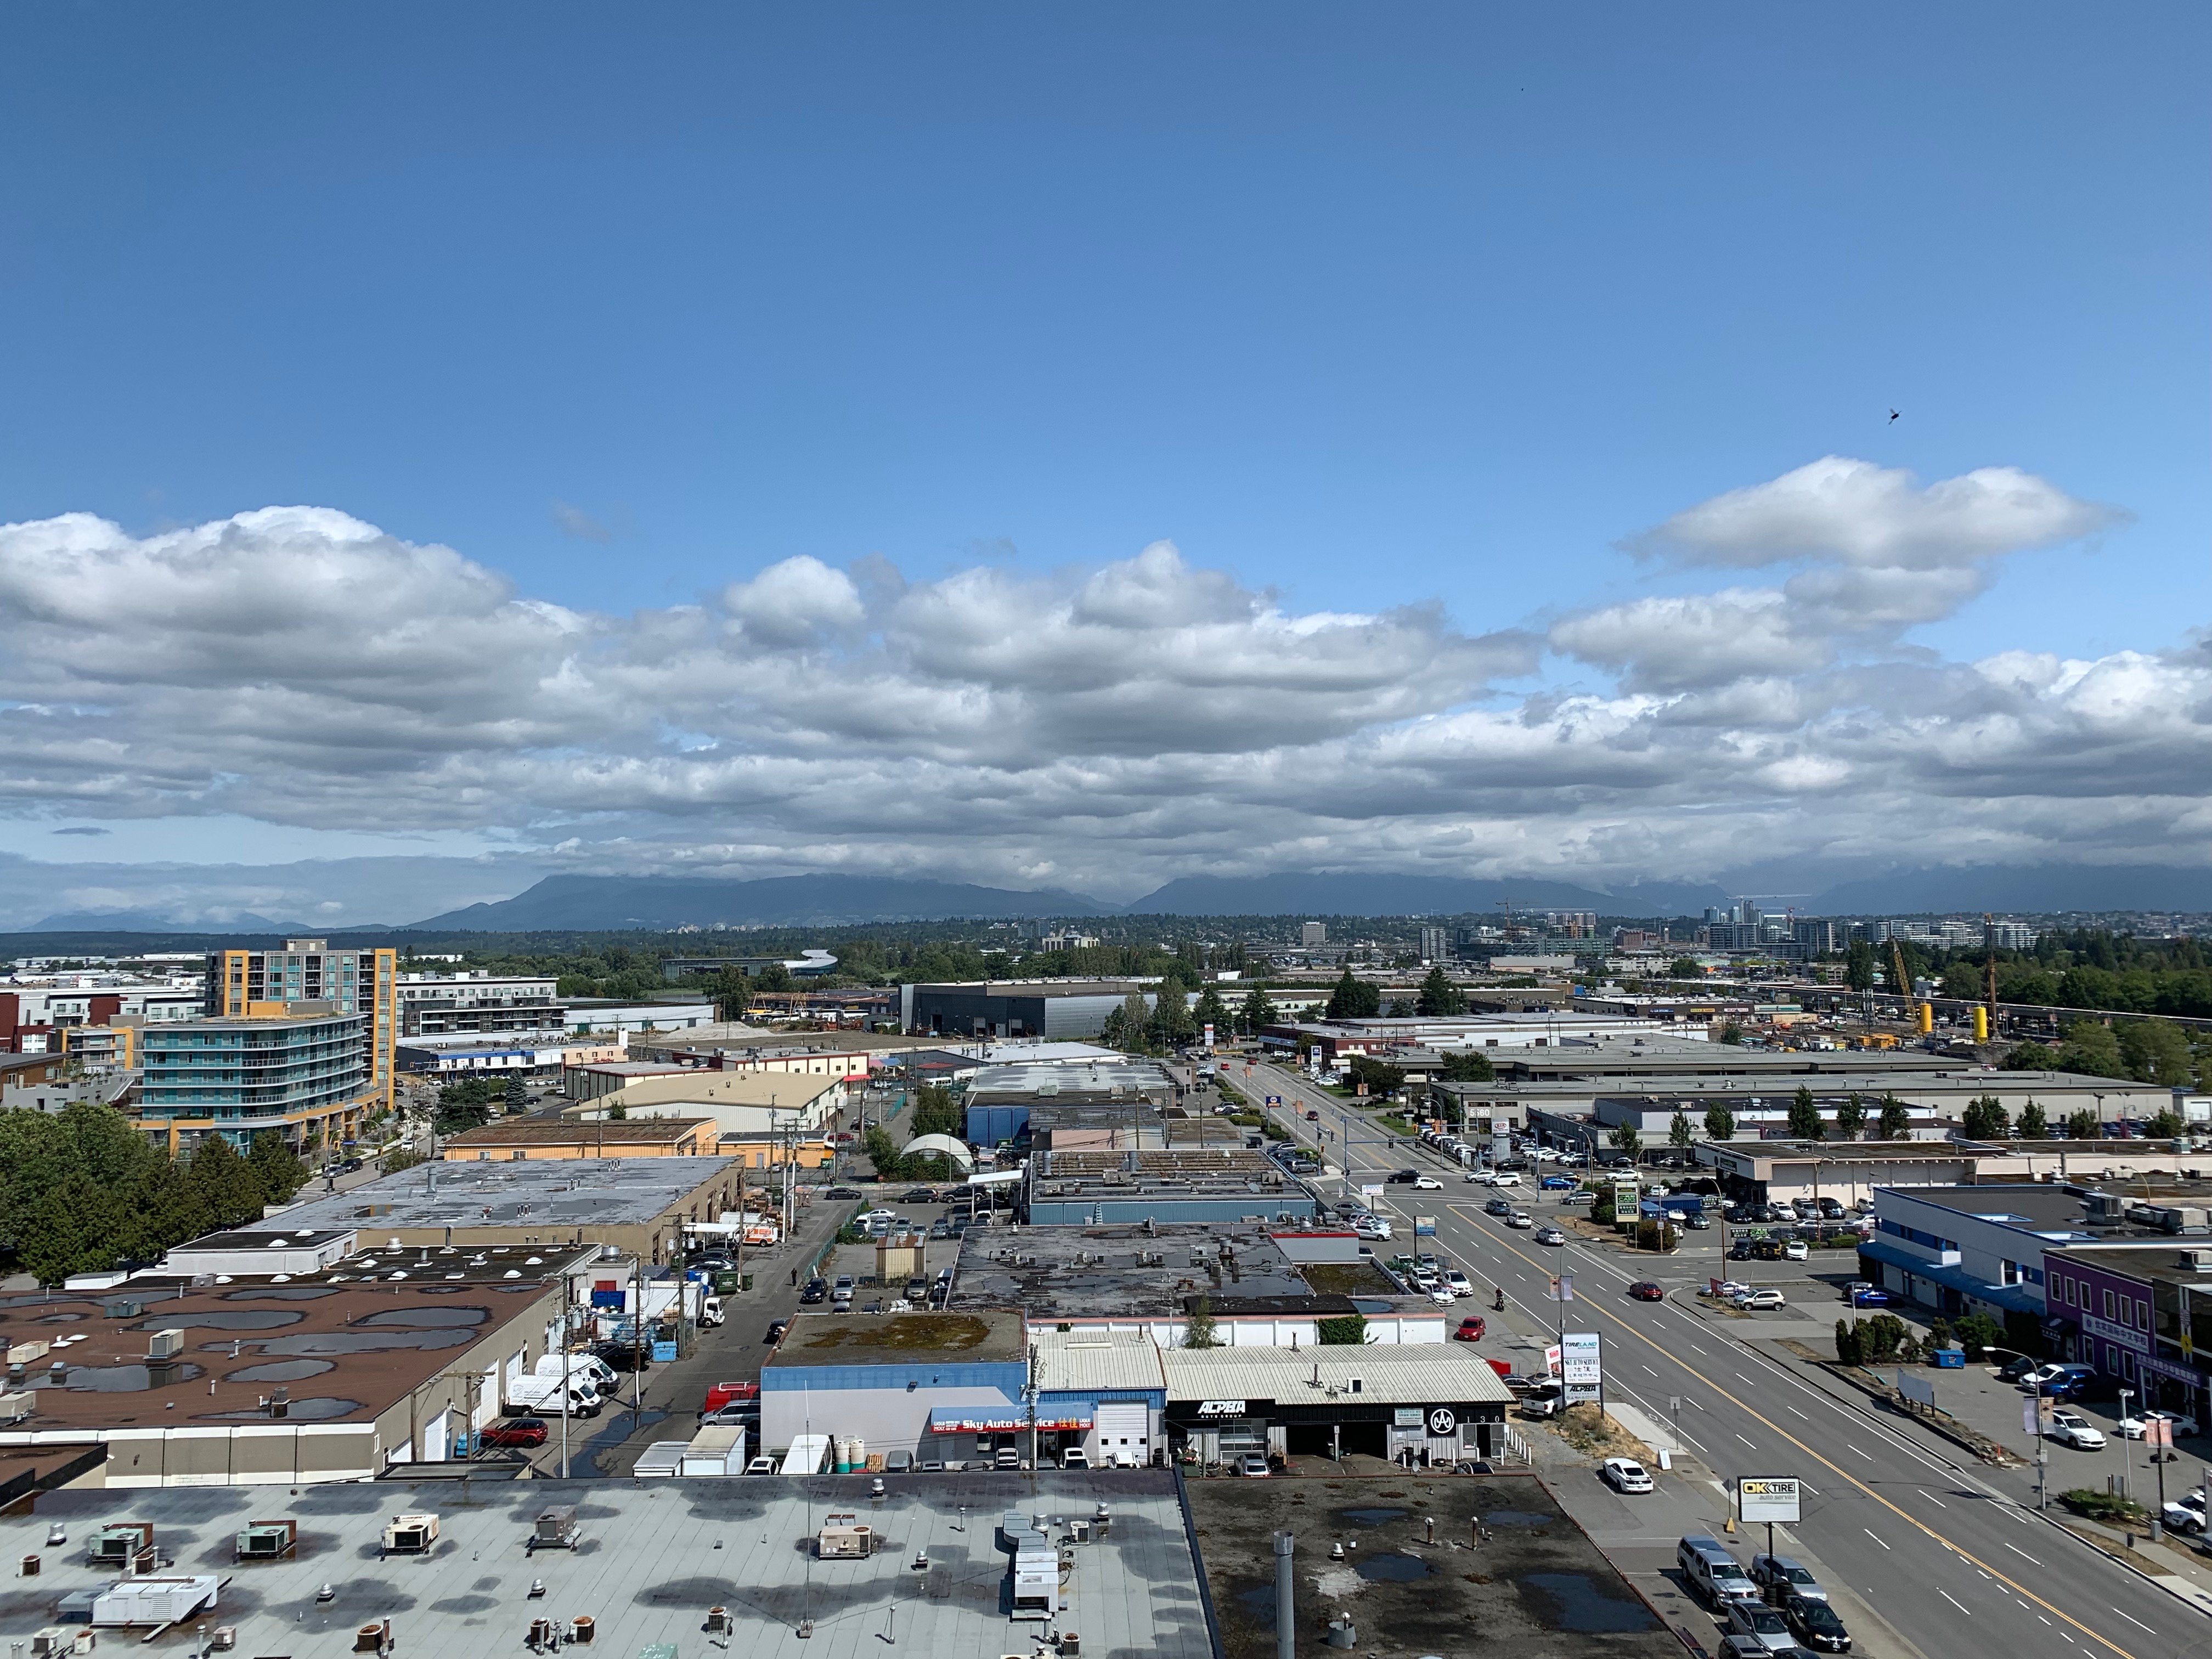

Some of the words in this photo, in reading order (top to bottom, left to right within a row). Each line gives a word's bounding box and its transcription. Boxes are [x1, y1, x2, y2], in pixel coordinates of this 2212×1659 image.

[1197, 1400, 1245, 1414] ALPHA
[963, 1420, 984, 1431] Sky
[986, 1419, 1013, 1429] Auto
[1014, 1418, 1055, 1428] Sevice
[1744, 1482, 1768, 1493] OK
[1772, 1484, 1793, 1492] TIRE
